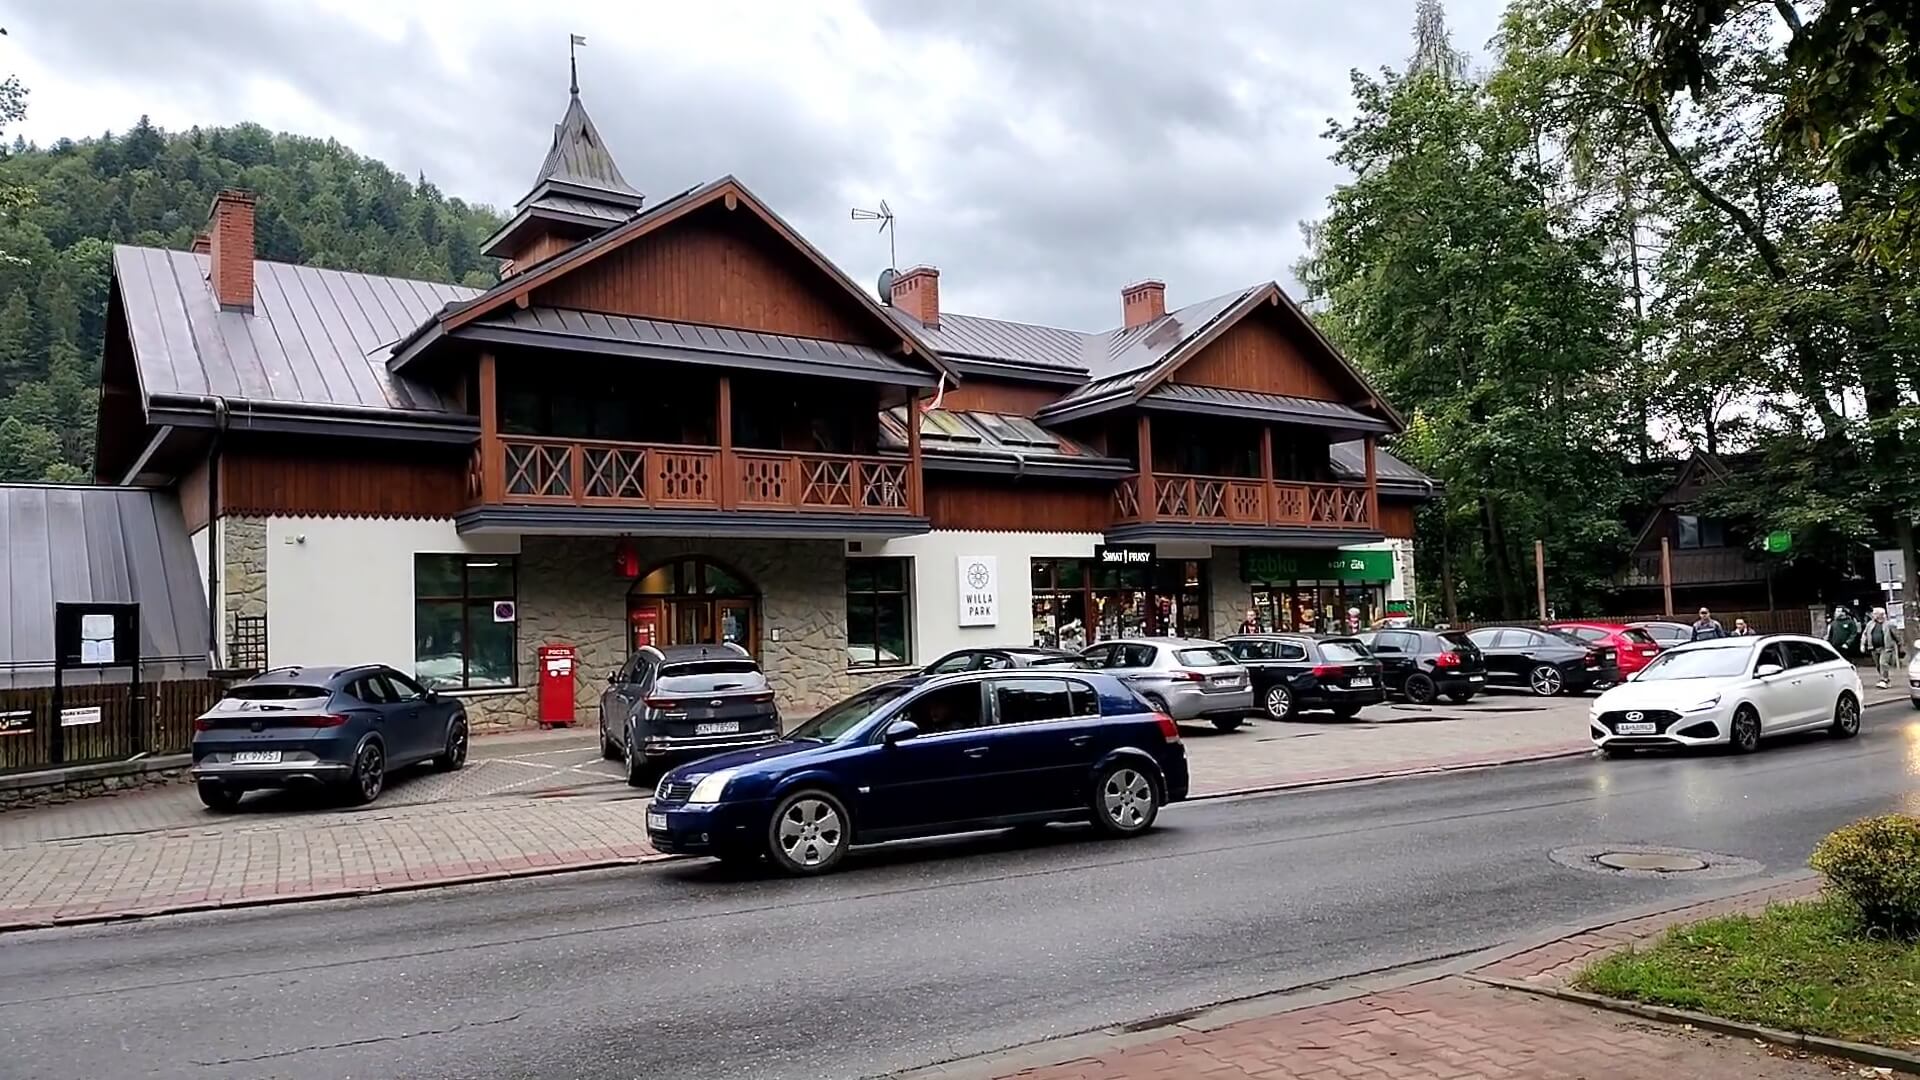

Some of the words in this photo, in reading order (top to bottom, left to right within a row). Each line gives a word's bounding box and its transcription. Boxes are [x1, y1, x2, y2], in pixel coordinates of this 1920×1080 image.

[1102, 549, 1123, 562] ŚWIAT
[1128, 552, 1151, 562] PRASY
[966, 593, 993, 604] WILLA
[969, 606, 991, 616] PARK
